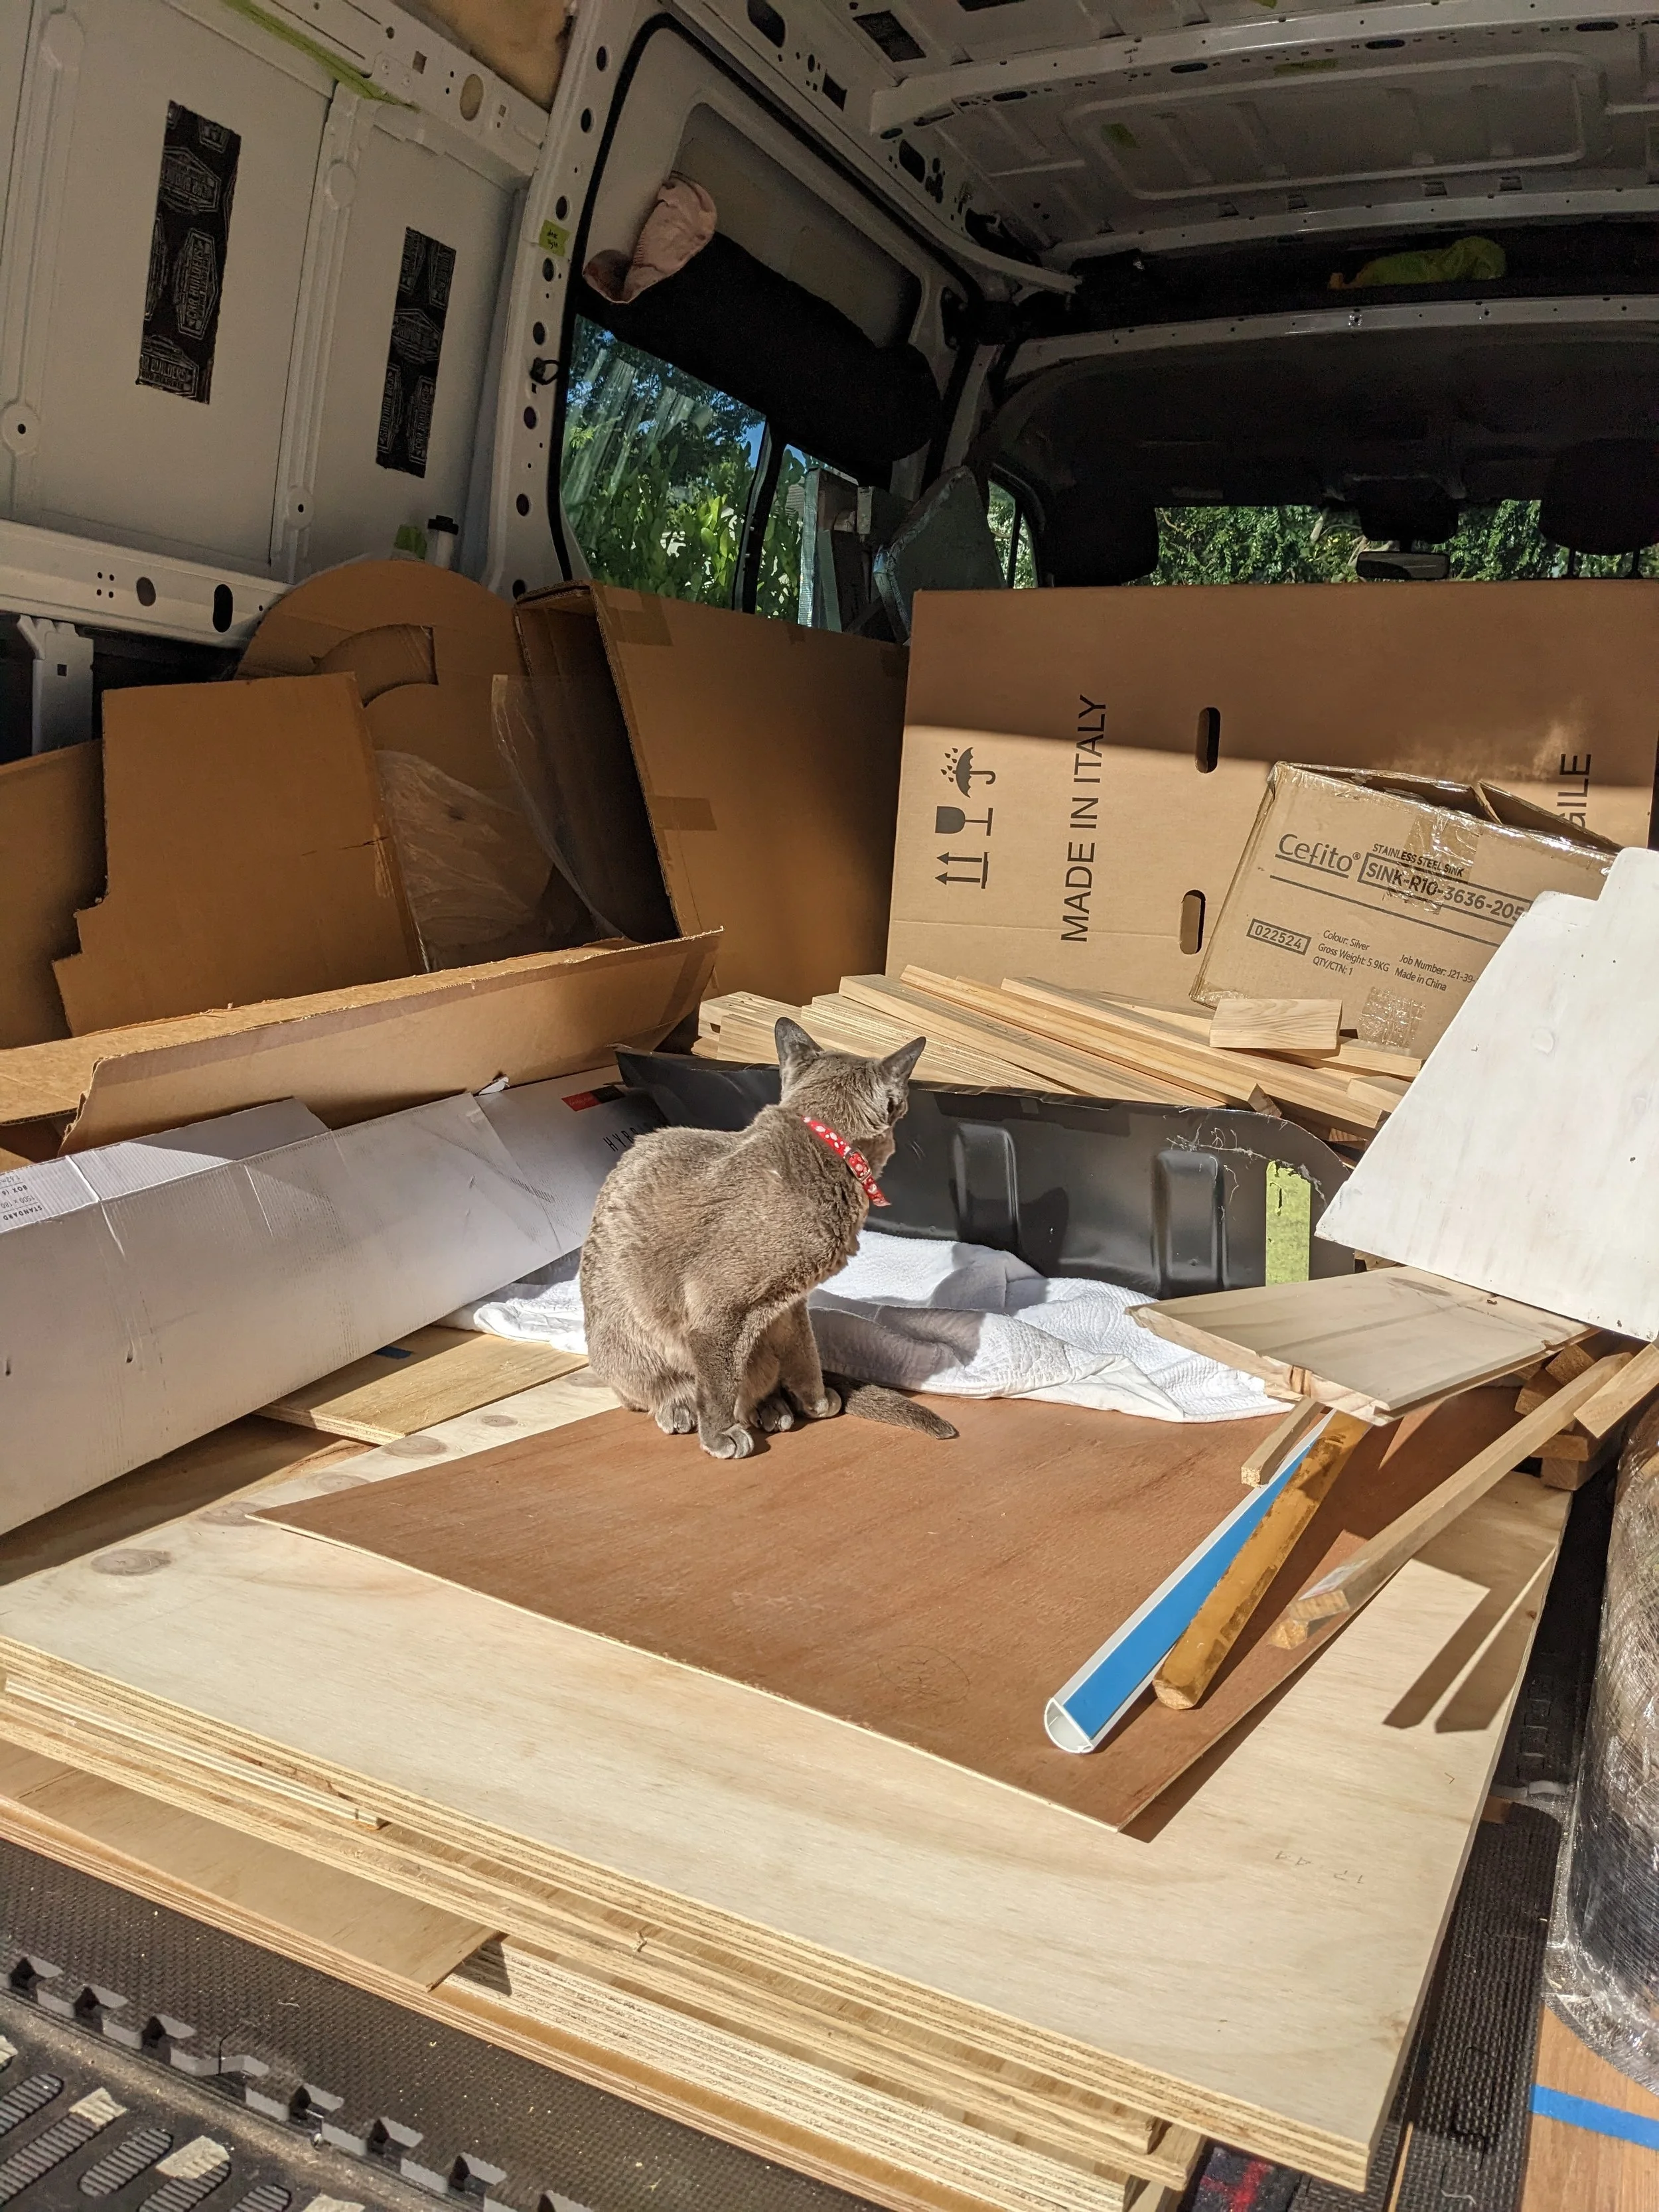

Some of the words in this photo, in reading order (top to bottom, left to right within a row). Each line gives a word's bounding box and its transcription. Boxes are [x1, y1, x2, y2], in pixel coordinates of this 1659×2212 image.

[1074, 694, 1106, 784] ITALY
[1070, 797, 1099, 829] IN
[1372, 843, 1417, 863] STAINLESS
[1417, 856, 1442, 871] STEEL
[1444, 863, 1465, 877] SINK
[1060, 842, 1095, 942] MADE
[1254, 924, 1302, 950] 022524
[1323, 930, 1348, 944] Colour:
[1349, 938, 1370, 951] Silver
[1313, 956, 1347, 974] QTY/CTN:
[1347, 967, 1354, 976] 1
[1318, 943, 1338, 956] Gross
[1338, 948, 1366, 965] Weight:
[1366, 958, 1390, 972] 5.9KG
[1399, 954, 1413, 965] Job
[1413, 958, 1447, 976] Number:
[1447, 969, 1479, 984] J21-39-
[1394, 967, 1416, 982] Made
[1416, 974, 1425, 984] in
[1425, 978, 1447, 992] China
[3, 1205, 42, 1220] STANDARD
